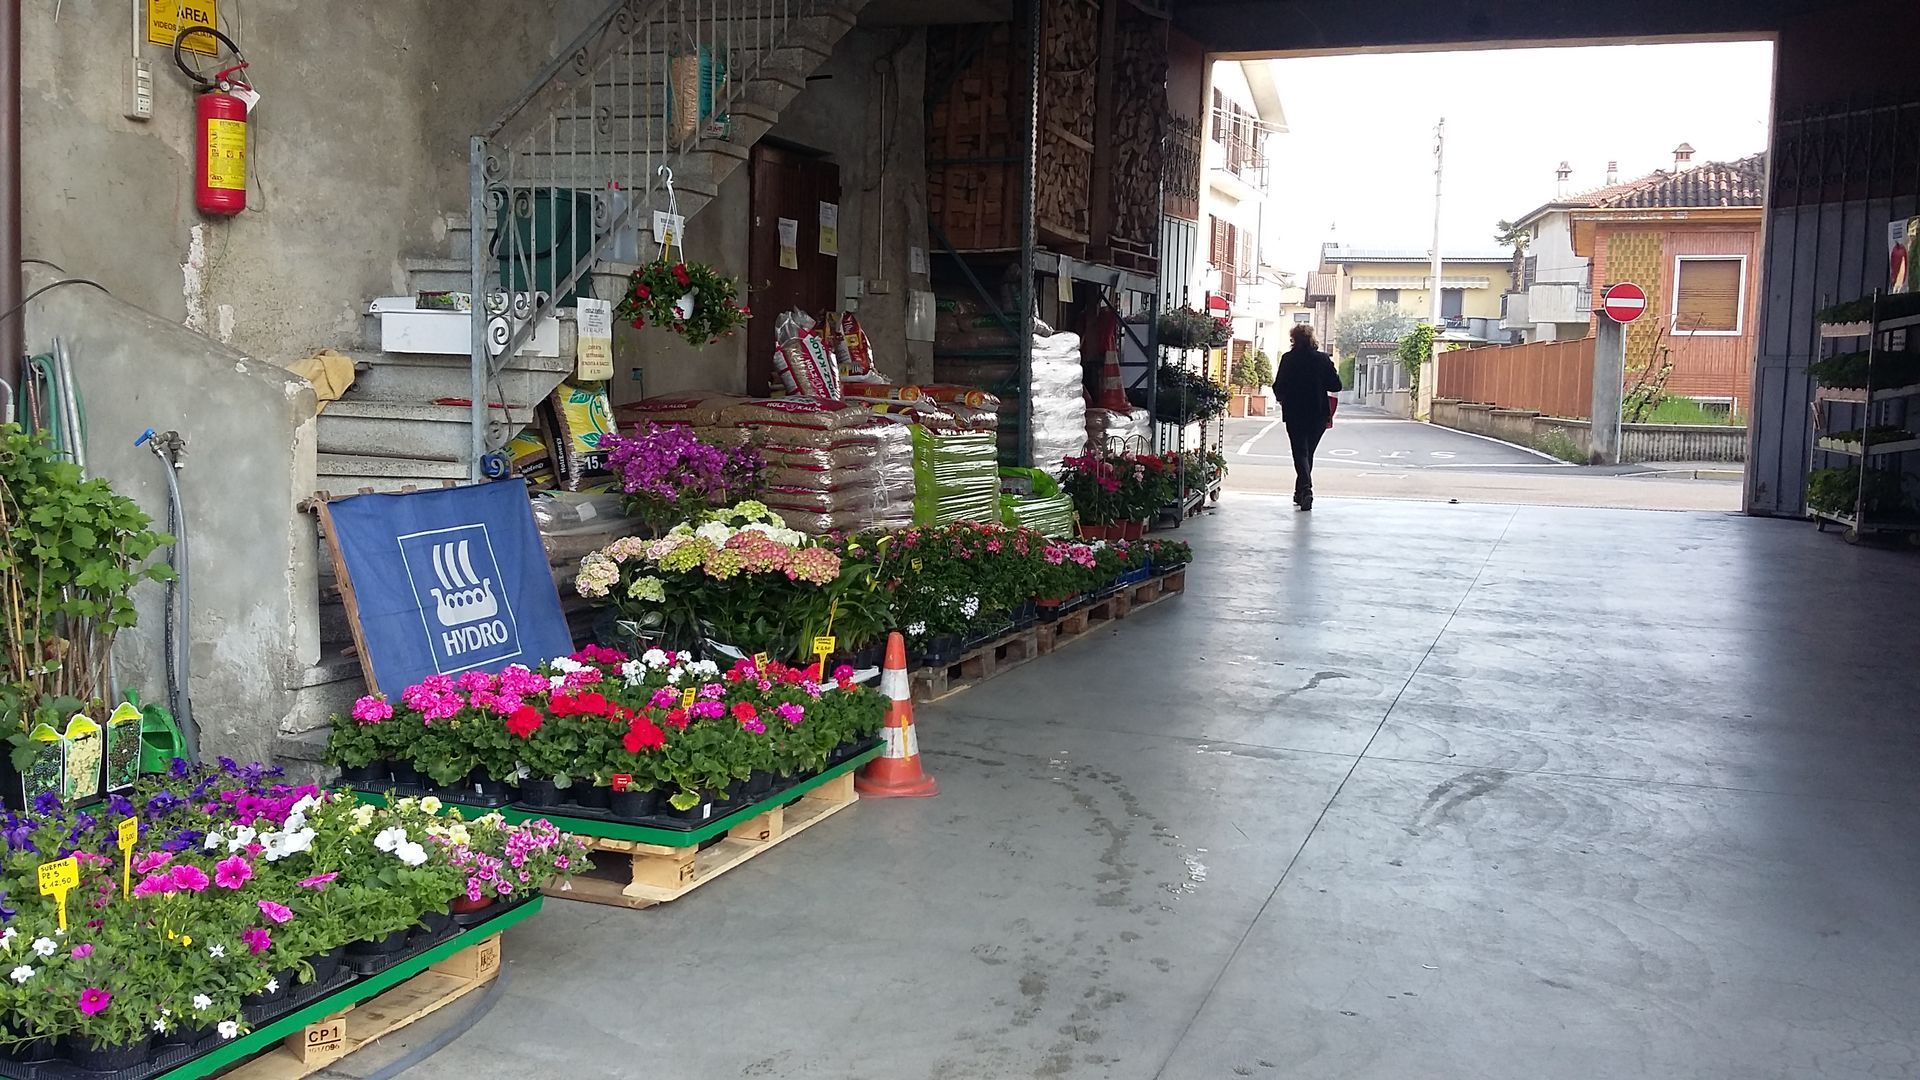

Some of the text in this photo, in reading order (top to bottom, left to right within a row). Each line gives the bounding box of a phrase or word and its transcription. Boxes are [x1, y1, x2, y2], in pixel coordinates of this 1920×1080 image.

[177, 6, 209, 24] AREA
[1328, 448, 1457, 460] STO
[585, 455, 599, 470] 15
[442, 619, 509, 657] HYDRO
